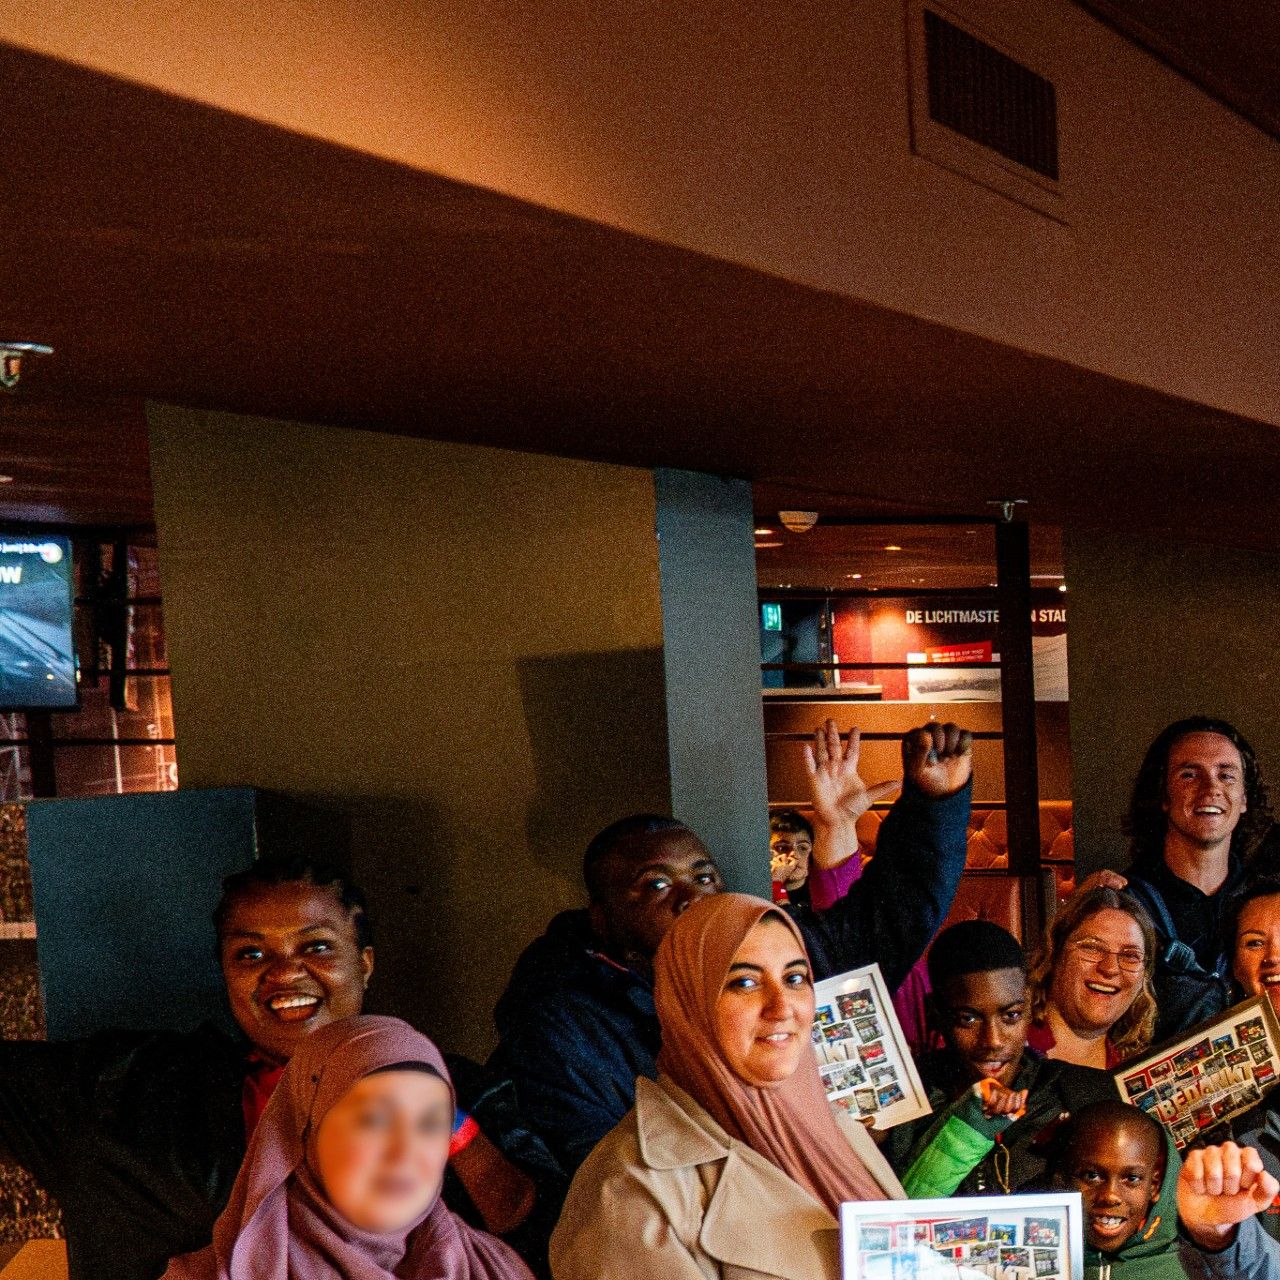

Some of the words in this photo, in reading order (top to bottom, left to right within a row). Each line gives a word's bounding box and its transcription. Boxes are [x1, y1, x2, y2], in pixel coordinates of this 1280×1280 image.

[906, 610, 923, 624] DE
[925, 610, 999, 624] LICHTMASTE
[1158, 1062, 1252, 1122] BEDANKT
